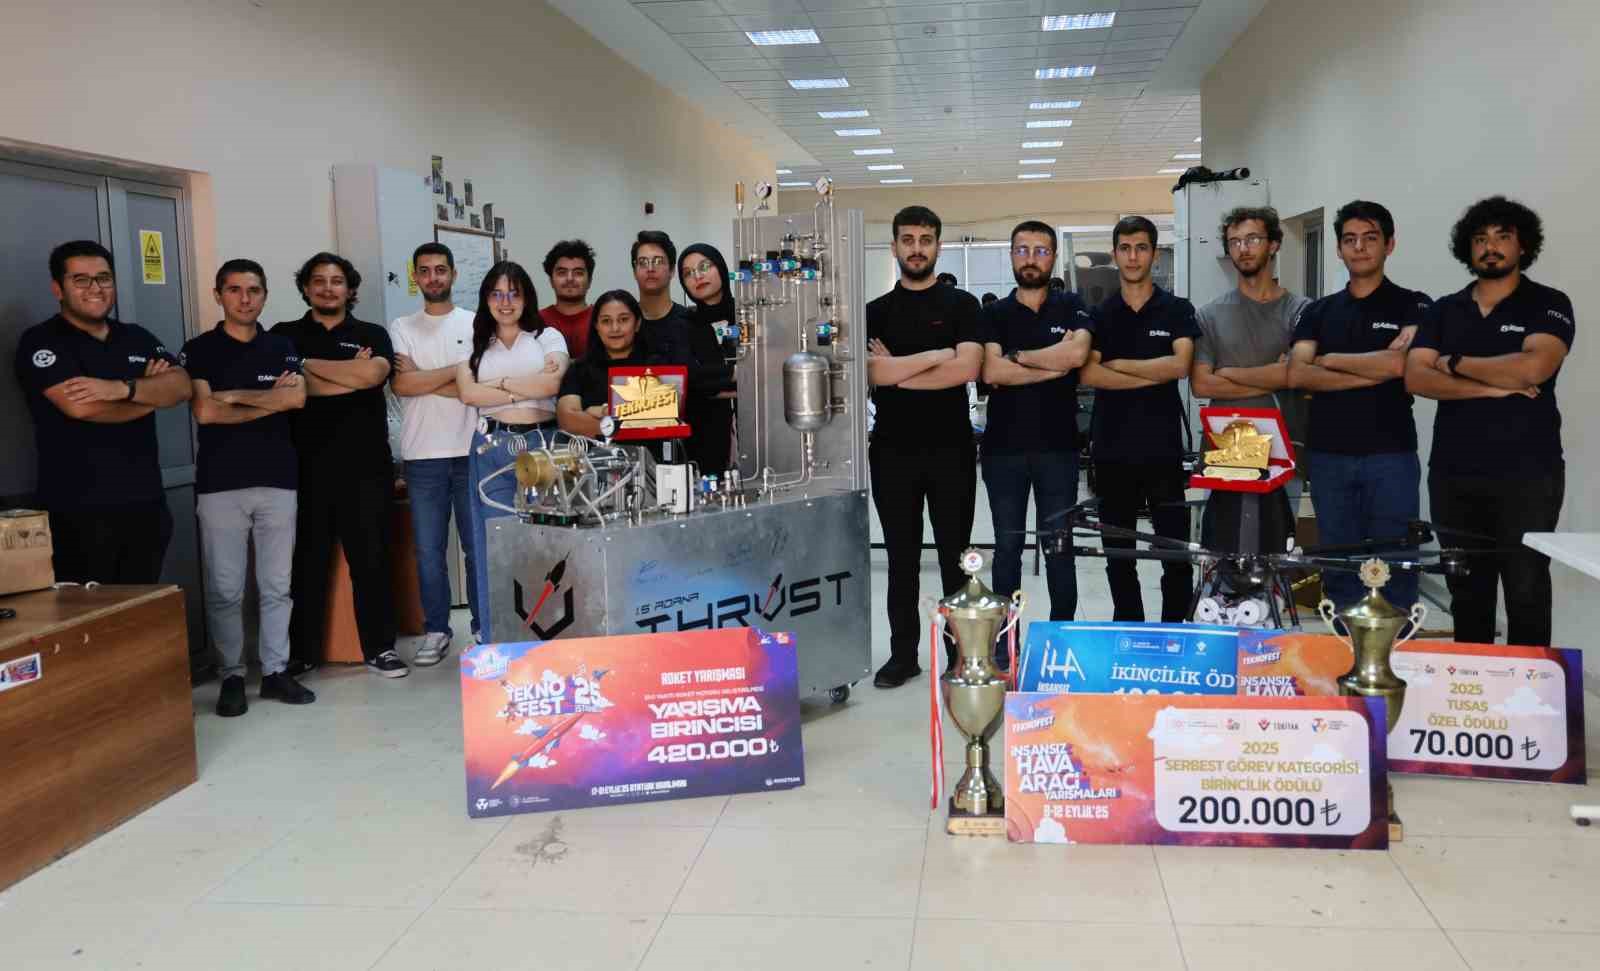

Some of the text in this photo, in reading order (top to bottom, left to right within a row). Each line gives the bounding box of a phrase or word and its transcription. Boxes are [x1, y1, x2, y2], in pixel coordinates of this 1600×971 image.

[1110, 662, 1238, 688] İKİNCİLİK ÖD
[1449, 682, 1483, 695] 2025
[515, 697, 562, 716] FEST
[1427, 712, 1461, 727] ÖZEL
[1241, 741, 1280, 755] 2025
[1409, 729, 1513, 760] 70.000
[1017, 754, 1074, 774] HAVA
[1165, 759, 1224, 772] SERBEST
[1227, 757, 1275, 773] GÖREV
[1275, 778, 1322, 792] ÖDÜLÜ
[1178, 795, 1315, 826] 200.000
